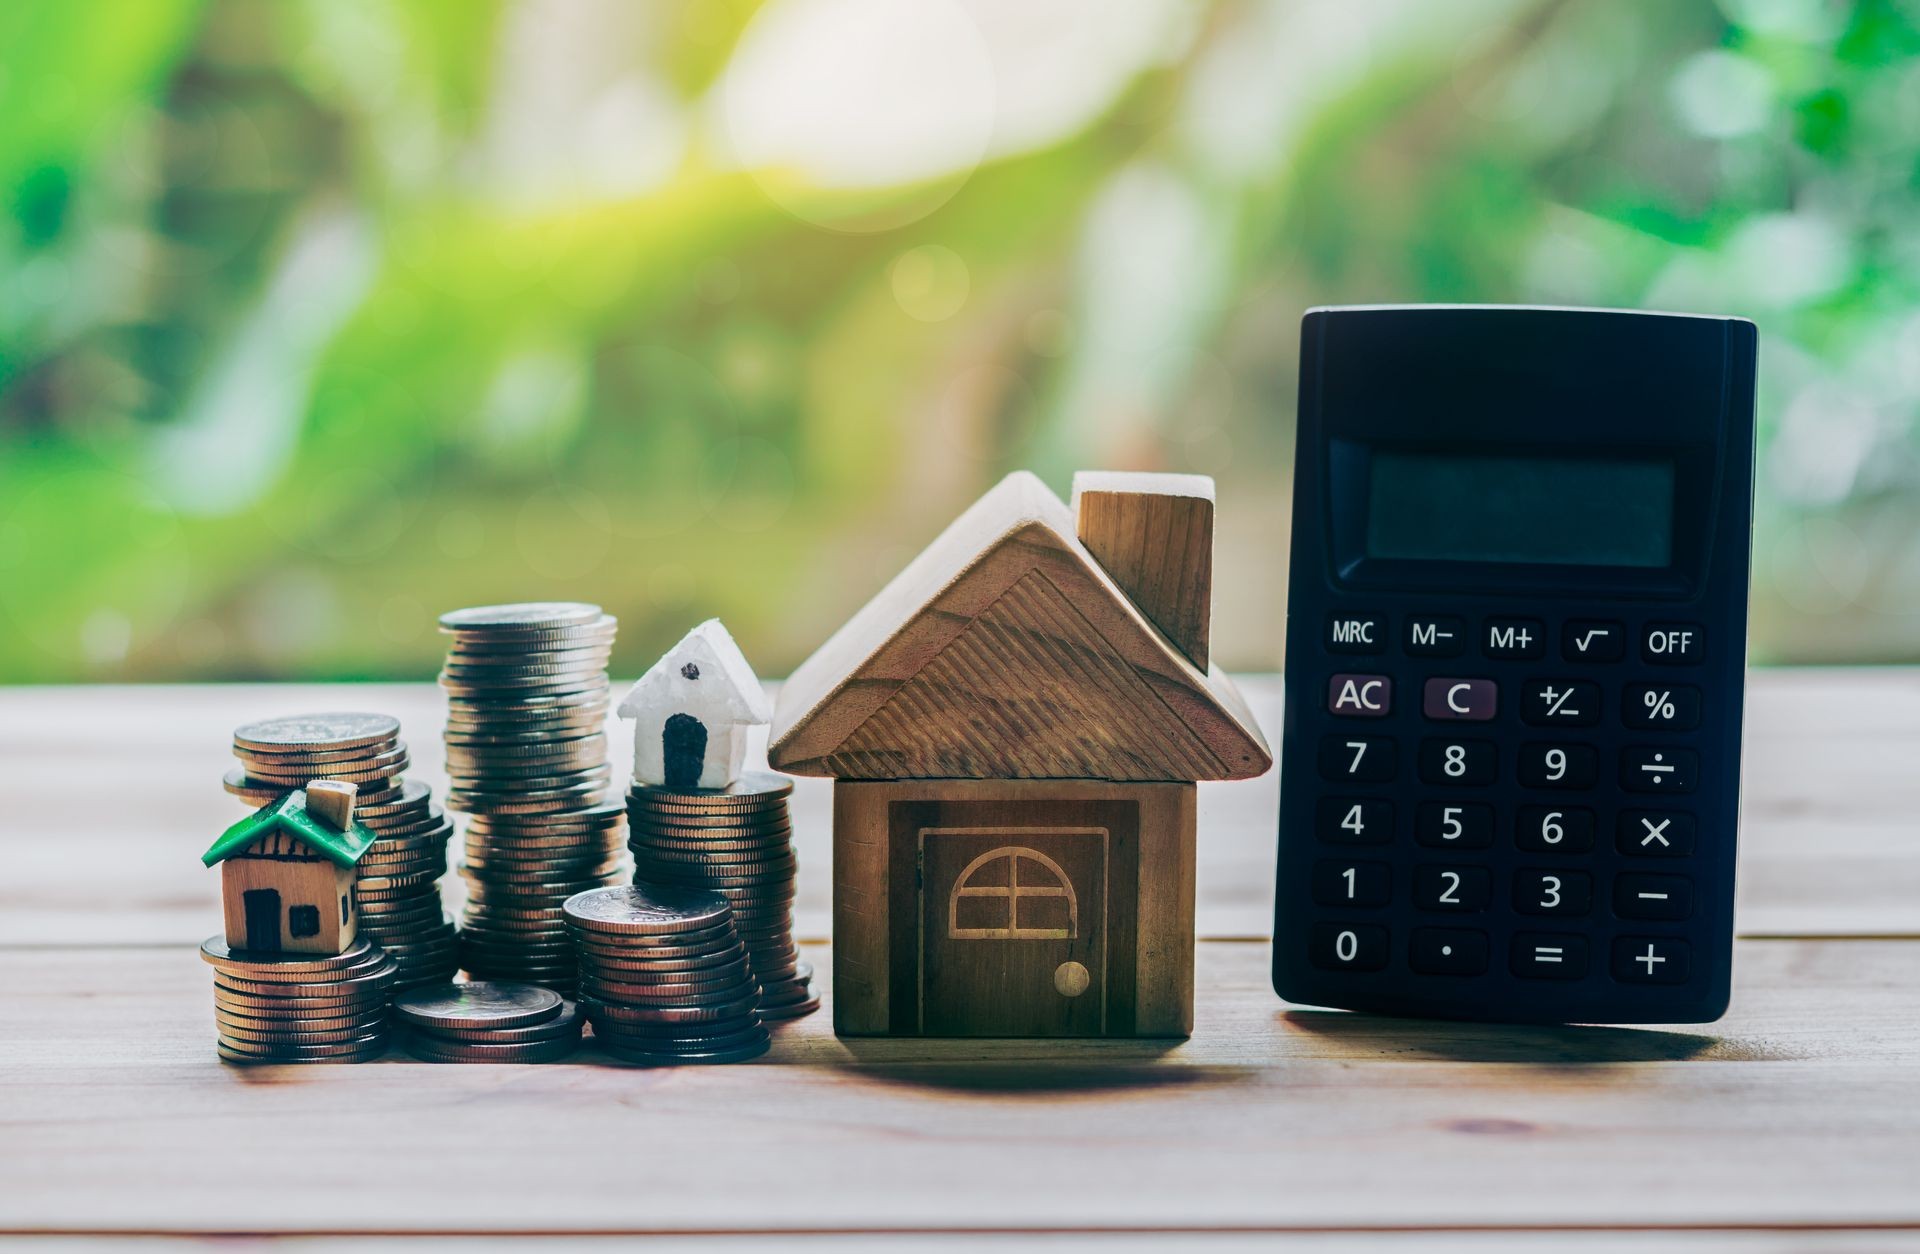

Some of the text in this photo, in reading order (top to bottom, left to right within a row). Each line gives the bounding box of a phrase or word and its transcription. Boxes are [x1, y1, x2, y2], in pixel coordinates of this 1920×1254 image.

[1333, 620, 1374, 644] MRC
[1490, 626, 1533, 649] M+
[1648, 630, 1693, 654] OFF
[1335, 679, 1383, 710] AC
[1447, 683, 1471, 714] C
[1644, 690, 1675, 719] %
[1346, 741, 1367, 773] 7
[1443, 745, 1466, 777] 8
[1545, 749, 1567, 781] 9
[1340, 804, 1365, 835] 4
[1442, 807, 1463, 840] 5
[1542, 812, 1564, 844] 6
[1342, 868, 1355, 899] 1
[1439, 871, 1460, 904] 2
[1540, 875, 1561, 908] 3
[1336, 930, 1358, 961] 0
[1535, 947, 1563, 963] =
[1635, 943, 1666, 975] +
